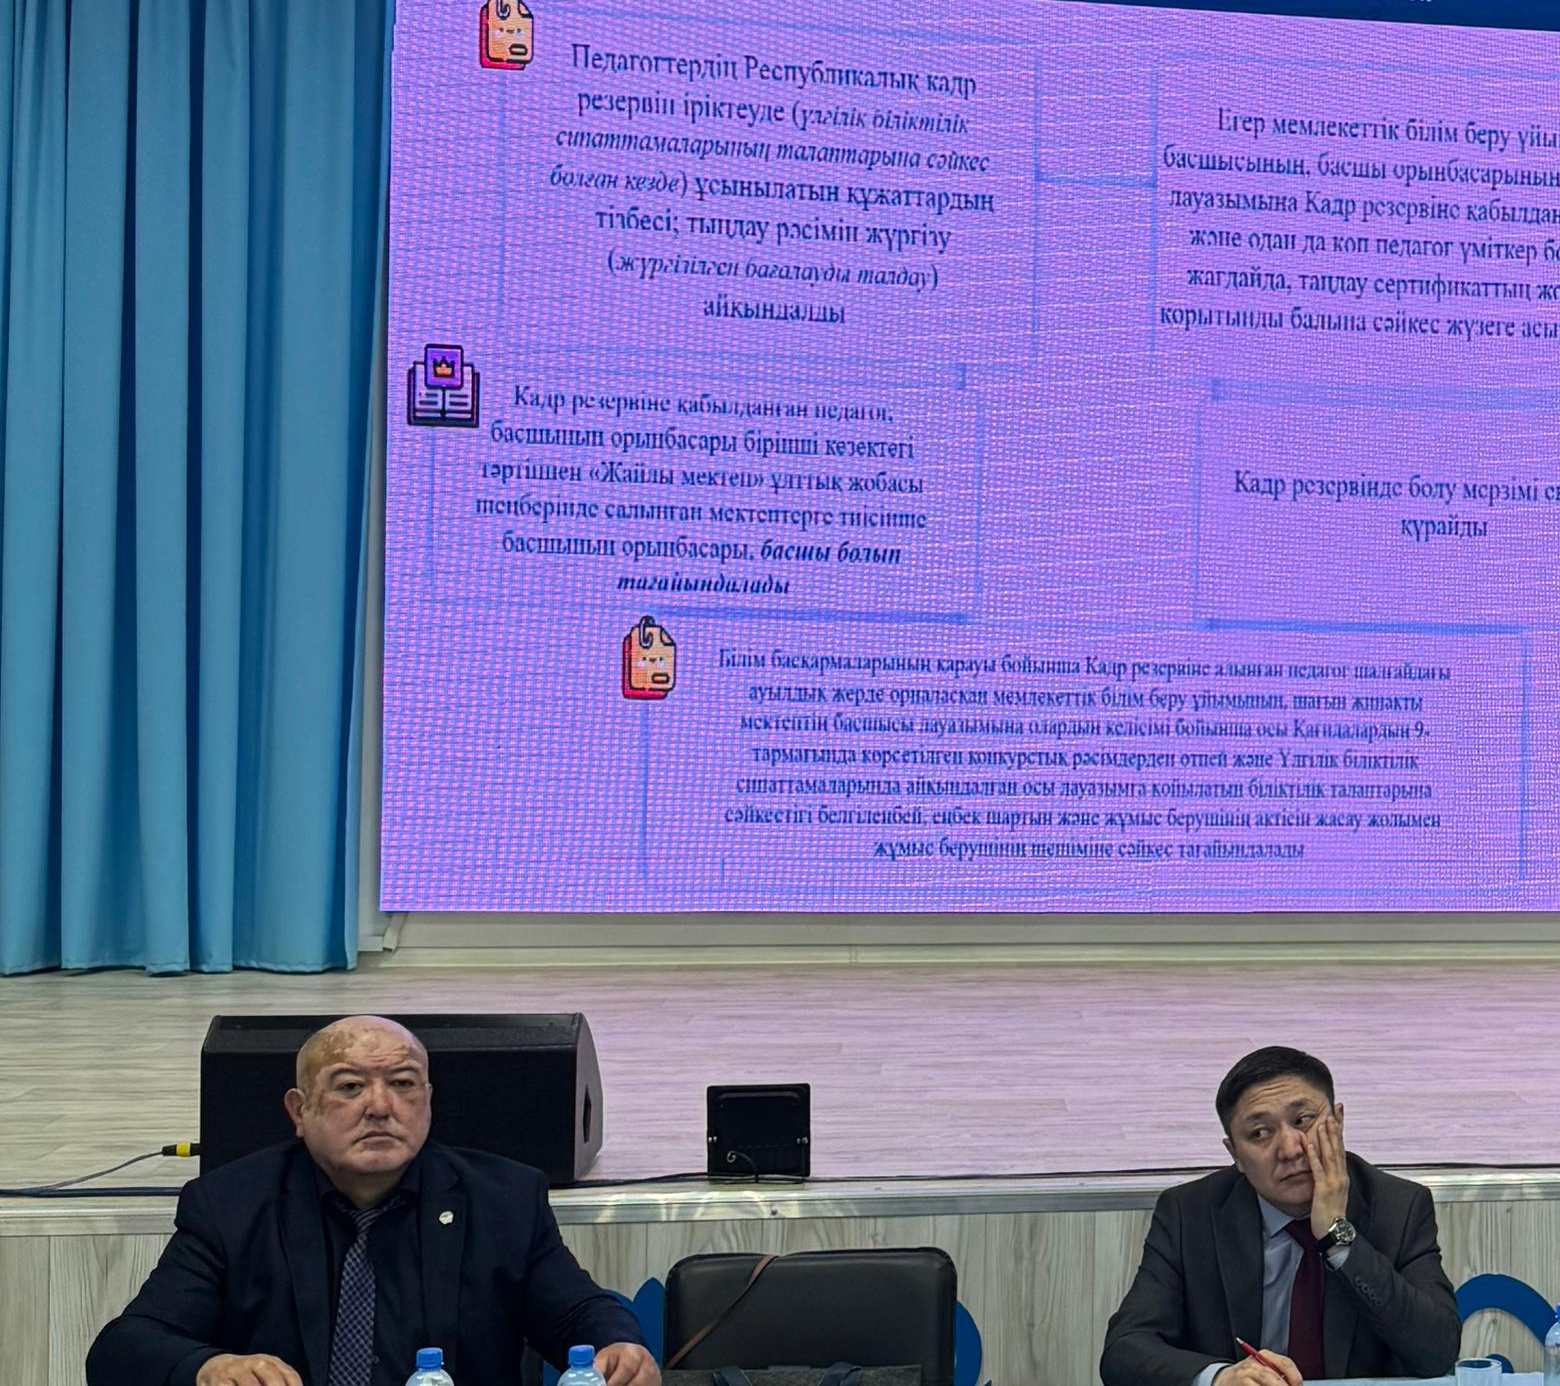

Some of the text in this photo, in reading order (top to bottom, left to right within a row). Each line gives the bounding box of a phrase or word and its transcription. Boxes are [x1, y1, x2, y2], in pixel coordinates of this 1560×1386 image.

[572, 43, 738, 82] Педагогтердің
[927, 73, 977, 100] кадр
[578, 91, 674, 120] резервін
[684, 92, 784, 127] іріктеуде
[1219, 107, 1265, 139] Егер
[1272, 117, 1399, 139] мемлекеттік
[1406, 119, 1457, 143] білім
[1465, 122, 1509, 152] беру
[777, 144, 920, 170] талаптарына
[927, 152, 990, 172] сәйкес
[1318, 152, 1386, 178] басшы
[625, 170, 687, 199] кезде)
[695, 177, 839, 201] ұсынылатын
[1169, 189, 1297, 213] лауазымына
[1305, 191, 1355, 221] Кадр
[777, 217, 858, 245] рәсімін
[867, 223, 951, 254] жүргізу
[1189, 230, 1241, 247] және
[1249, 233, 1296, 251] одан
[1302, 234, 1325, 253] да
[1376, 238, 1453, 258] педагог
[1373, 310, 1440, 334] сәйкес
[515, 385, 565, 413] Кадр
[611, 426, 737, 456] орынбасары
[825, 436, 914, 459] кезектегі
[847, 471, 923, 493] жобасы
[1234, 470, 1285, 501] Кадр
[1292, 473, 1402, 502] резервінде
[1409, 475, 1456, 505] болу
[1463, 476, 1538, 506] мерзімі
[761, 539, 831, 561] басшы
[838, 541, 902, 564] болып
[720, 648, 765, 668] Білім
[1001, 654, 1080, 674] бойынша
[1086, 656, 1126, 682] Кадр
[832, 687, 884, 706] жерде
[994, 690, 1095, 707] мемлекеттік
[1101, 687, 1143, 707] білім
[1150, 688, 1186, 711] беру
[1257, 722, 1287, 737] осы
[1233, 753, 1273, 768] және
[1023, 782, 1055, 796] осы
[1316, 813, 1360, 833] жасау
[1368, 813, 1440, 827] жолымен
